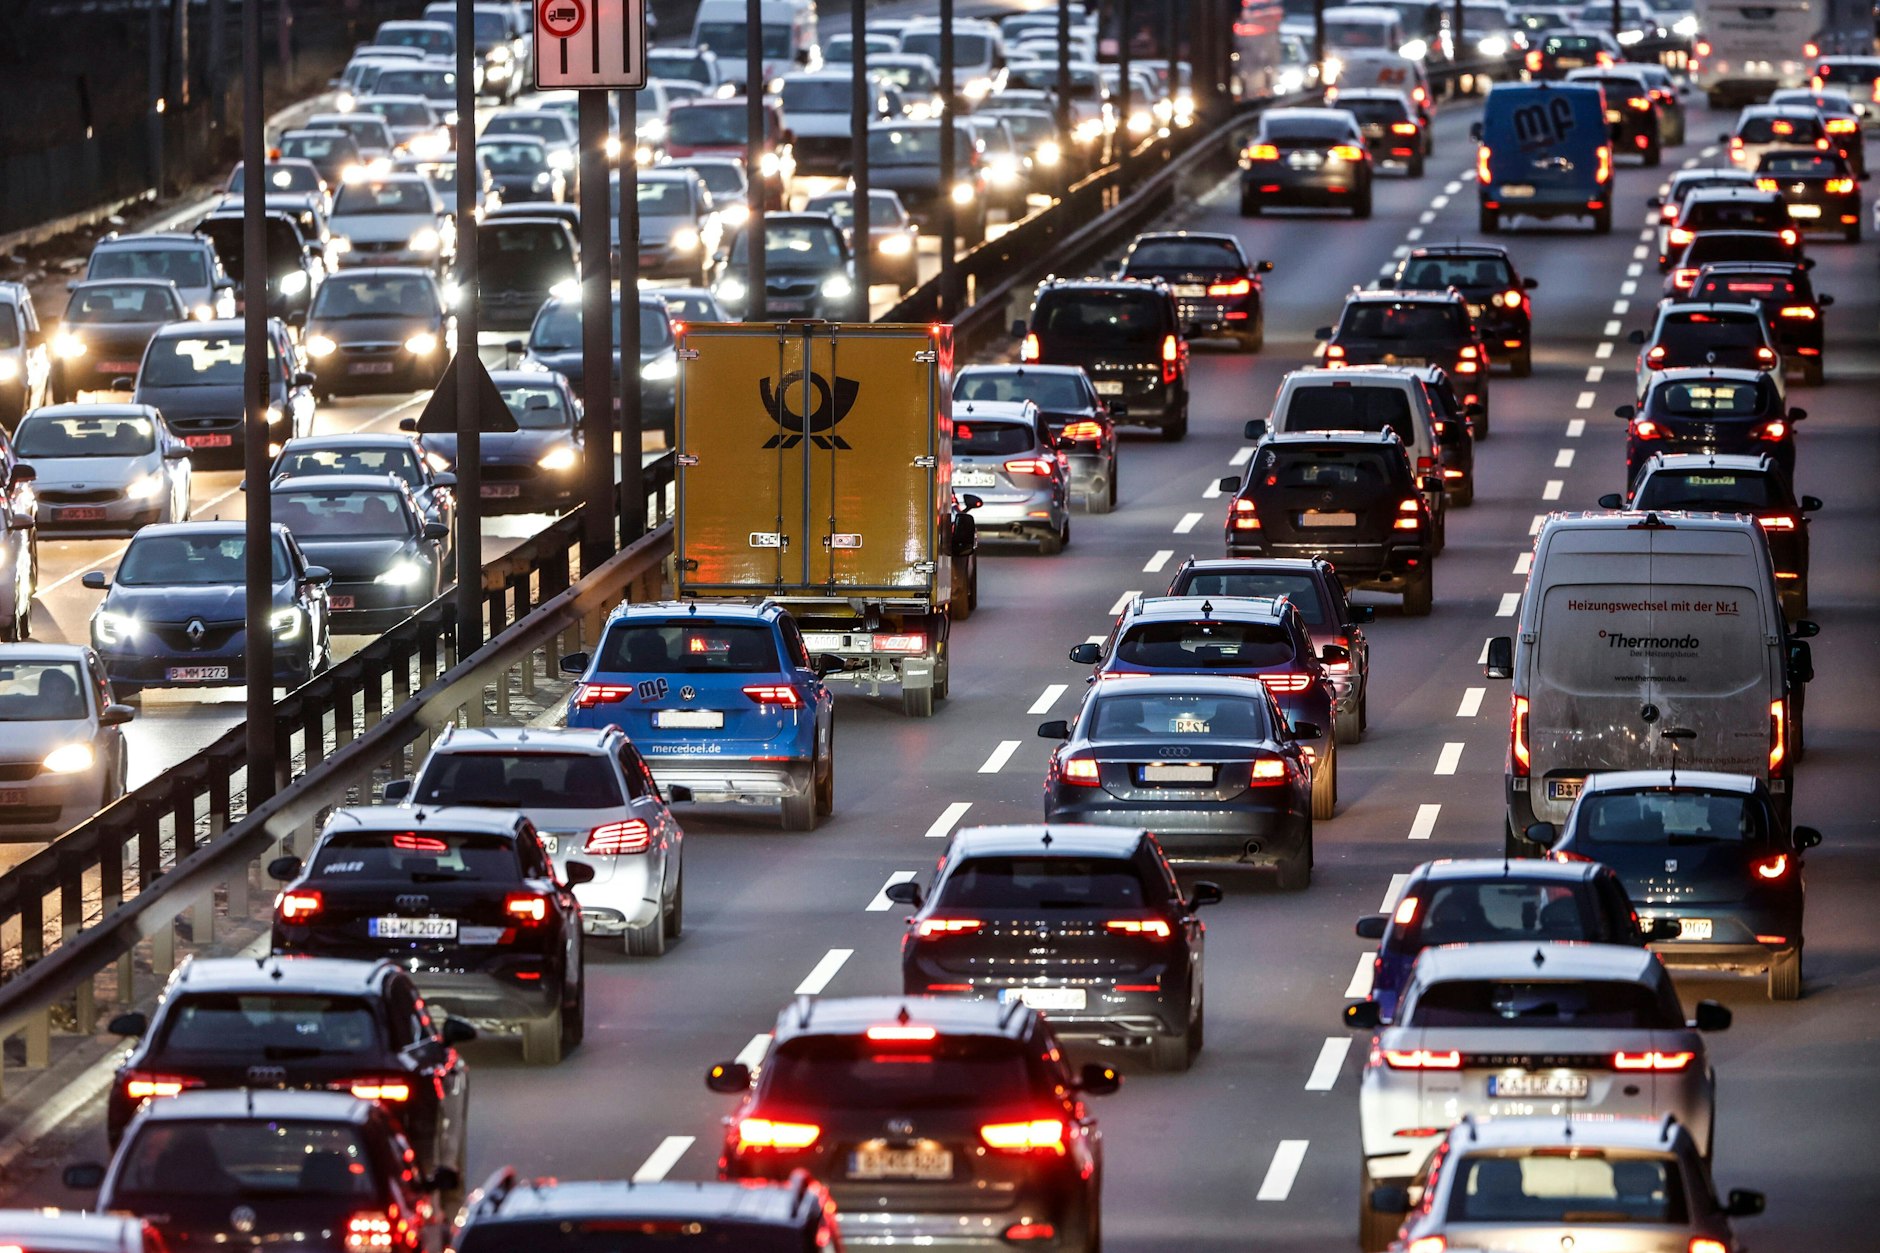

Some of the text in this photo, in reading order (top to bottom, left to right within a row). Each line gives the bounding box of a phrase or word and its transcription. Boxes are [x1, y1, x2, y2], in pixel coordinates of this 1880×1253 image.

[1568, 600, 1739, 613] Heizungswechsel mit der Nr.1
[1608, 633, 1699, 649] Thermondo
[172, 668, 178, 678] B
[201, 667, 227, 678] 1273
[1614, 674, 1687, 683] www.thermondo.de
[637, 677, 669, 700] mf
[652, 743, 721, 754] mercedoel.de
[1557, 783, 1564, 796] B
[380, 921, 388, 934] B
[419, 921, 452, 934] 2071
